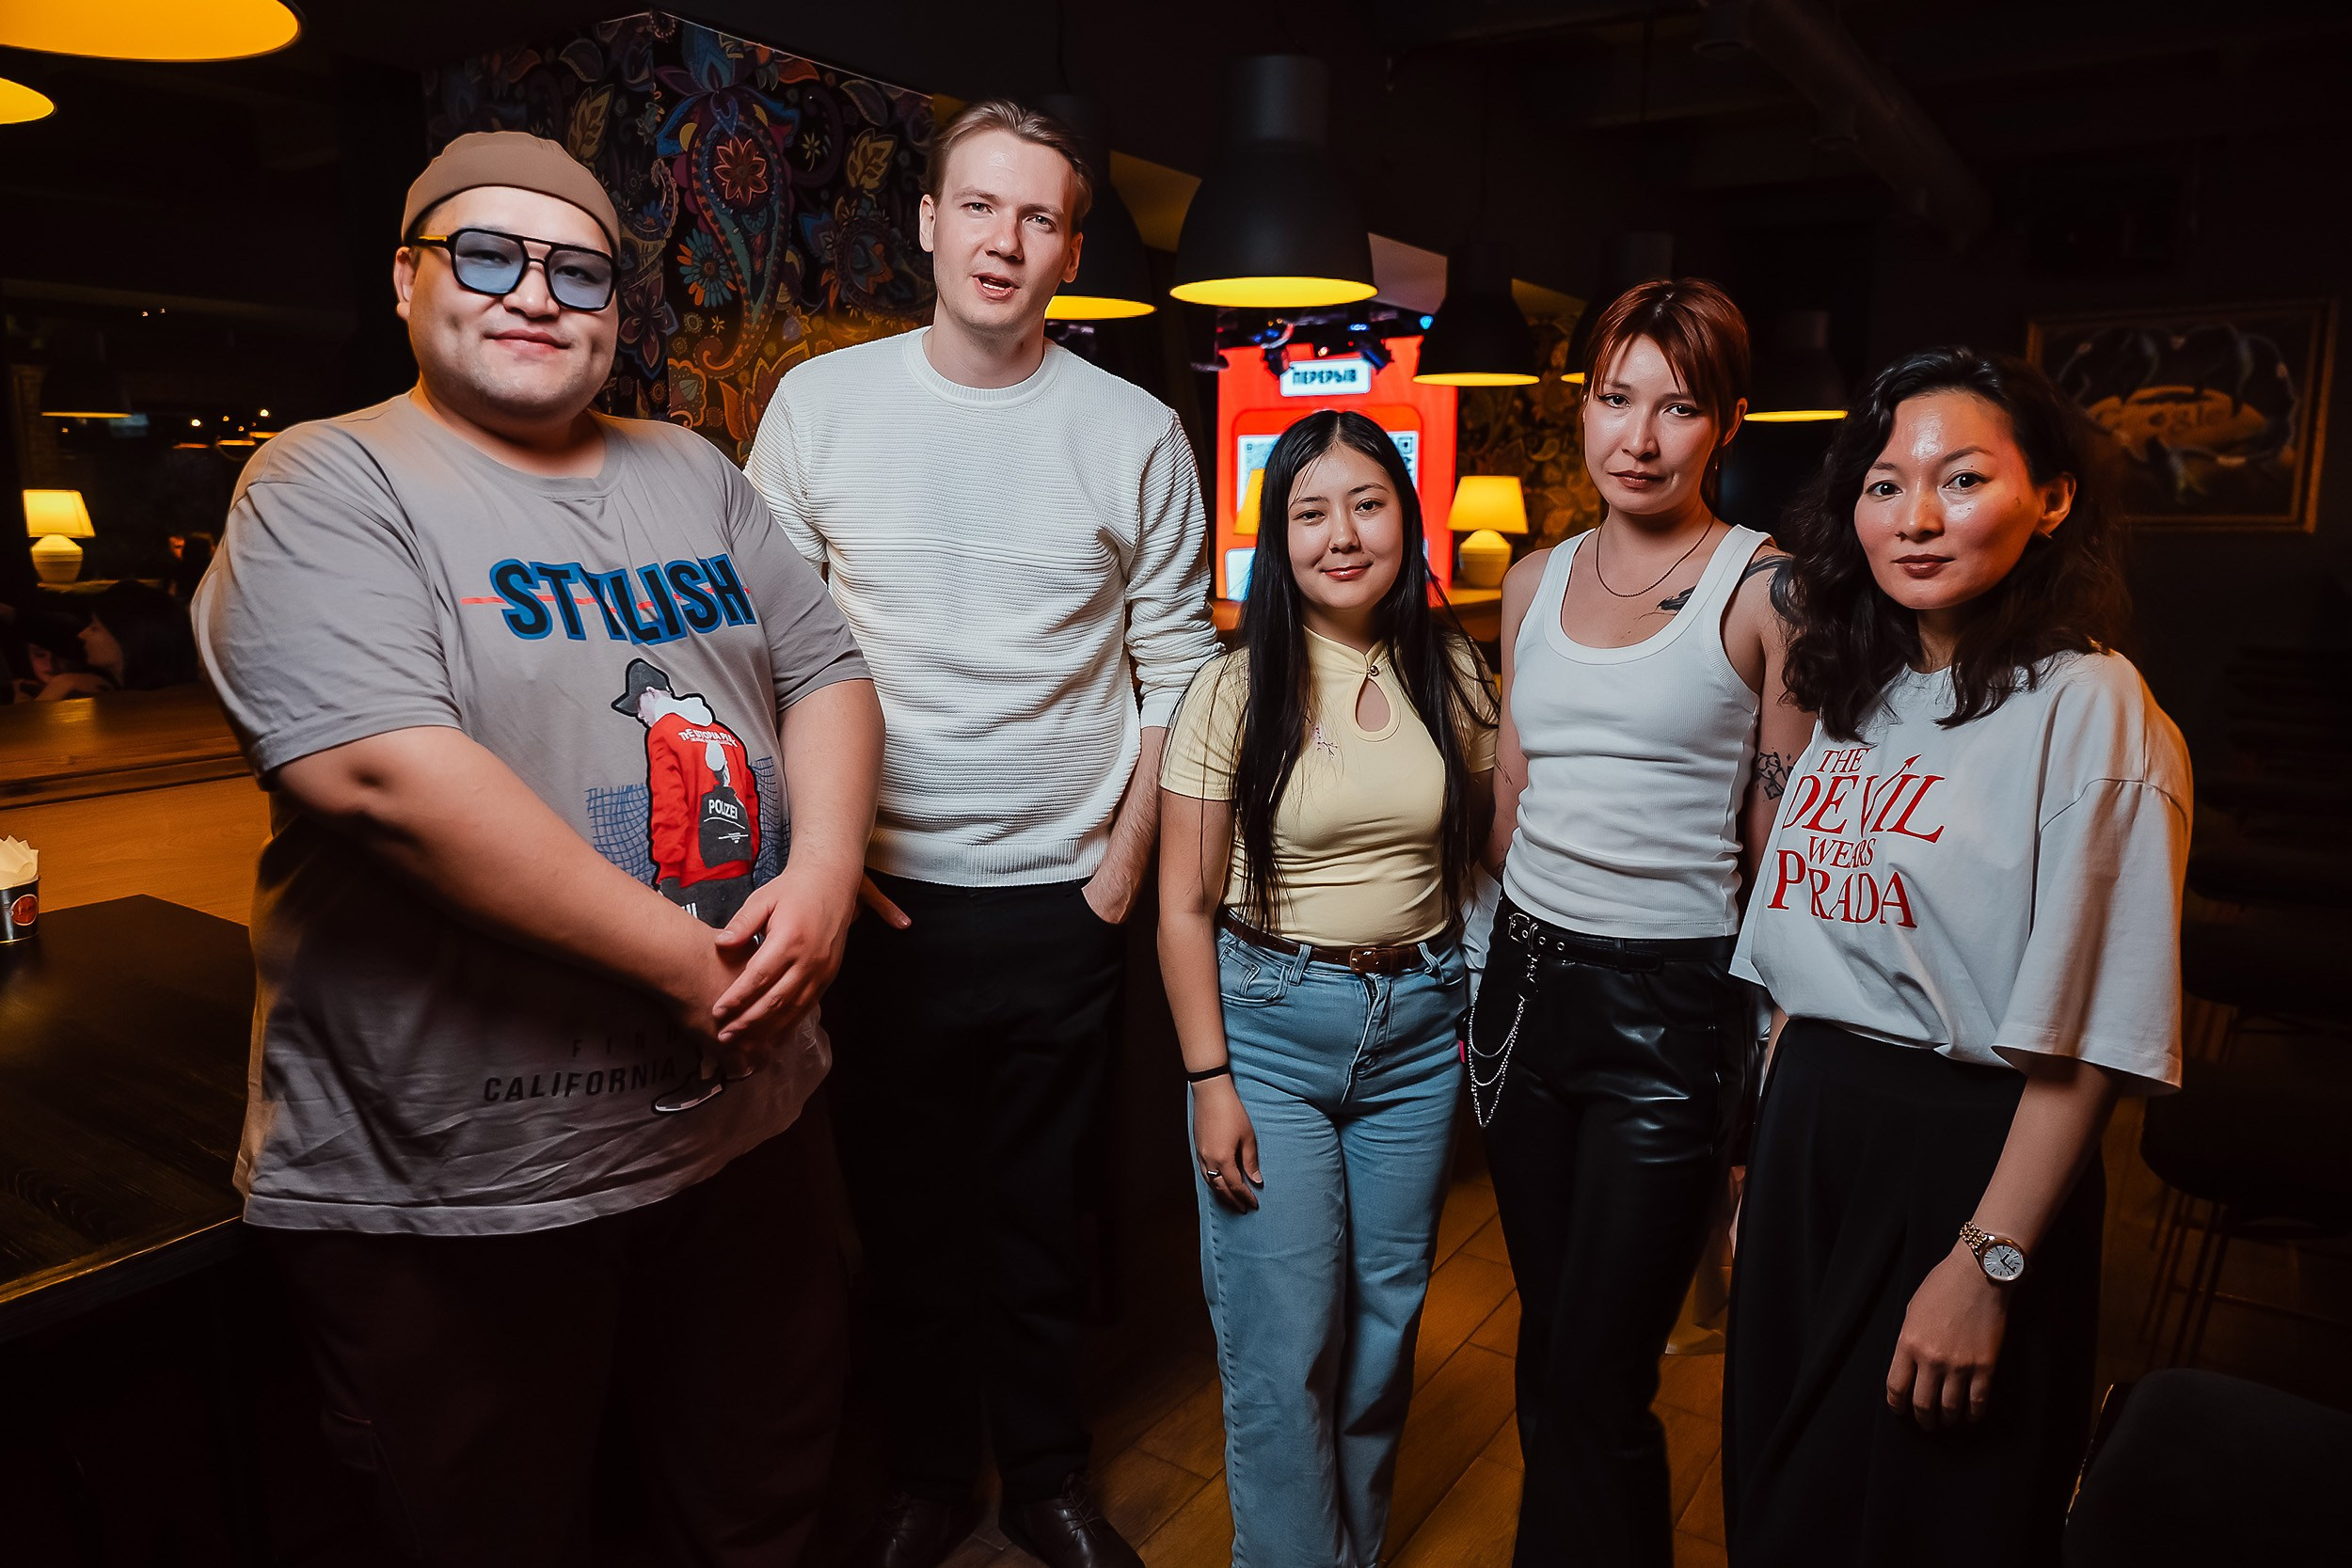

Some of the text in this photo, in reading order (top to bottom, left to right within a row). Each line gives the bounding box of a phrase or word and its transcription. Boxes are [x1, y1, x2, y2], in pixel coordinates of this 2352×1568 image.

[1292, 369, 1357, 385] ПЕРЕРЫВ
[489, 553, 756, 645] STYLISH
[678, 729, 695, 741] THE
[692, 730, 722, 740] UTOPIA
[1817, 748, 1870, 773] THE
[708, 800, 739, 819] POLIZEI
[1782, 754, 1946, 844] DEVIL
[1809, 835, 1877, 869] WEARS
[1767, 849, 1917, 929] PRADA
[484, 1057, 675, 1102] CALIFORNIA
